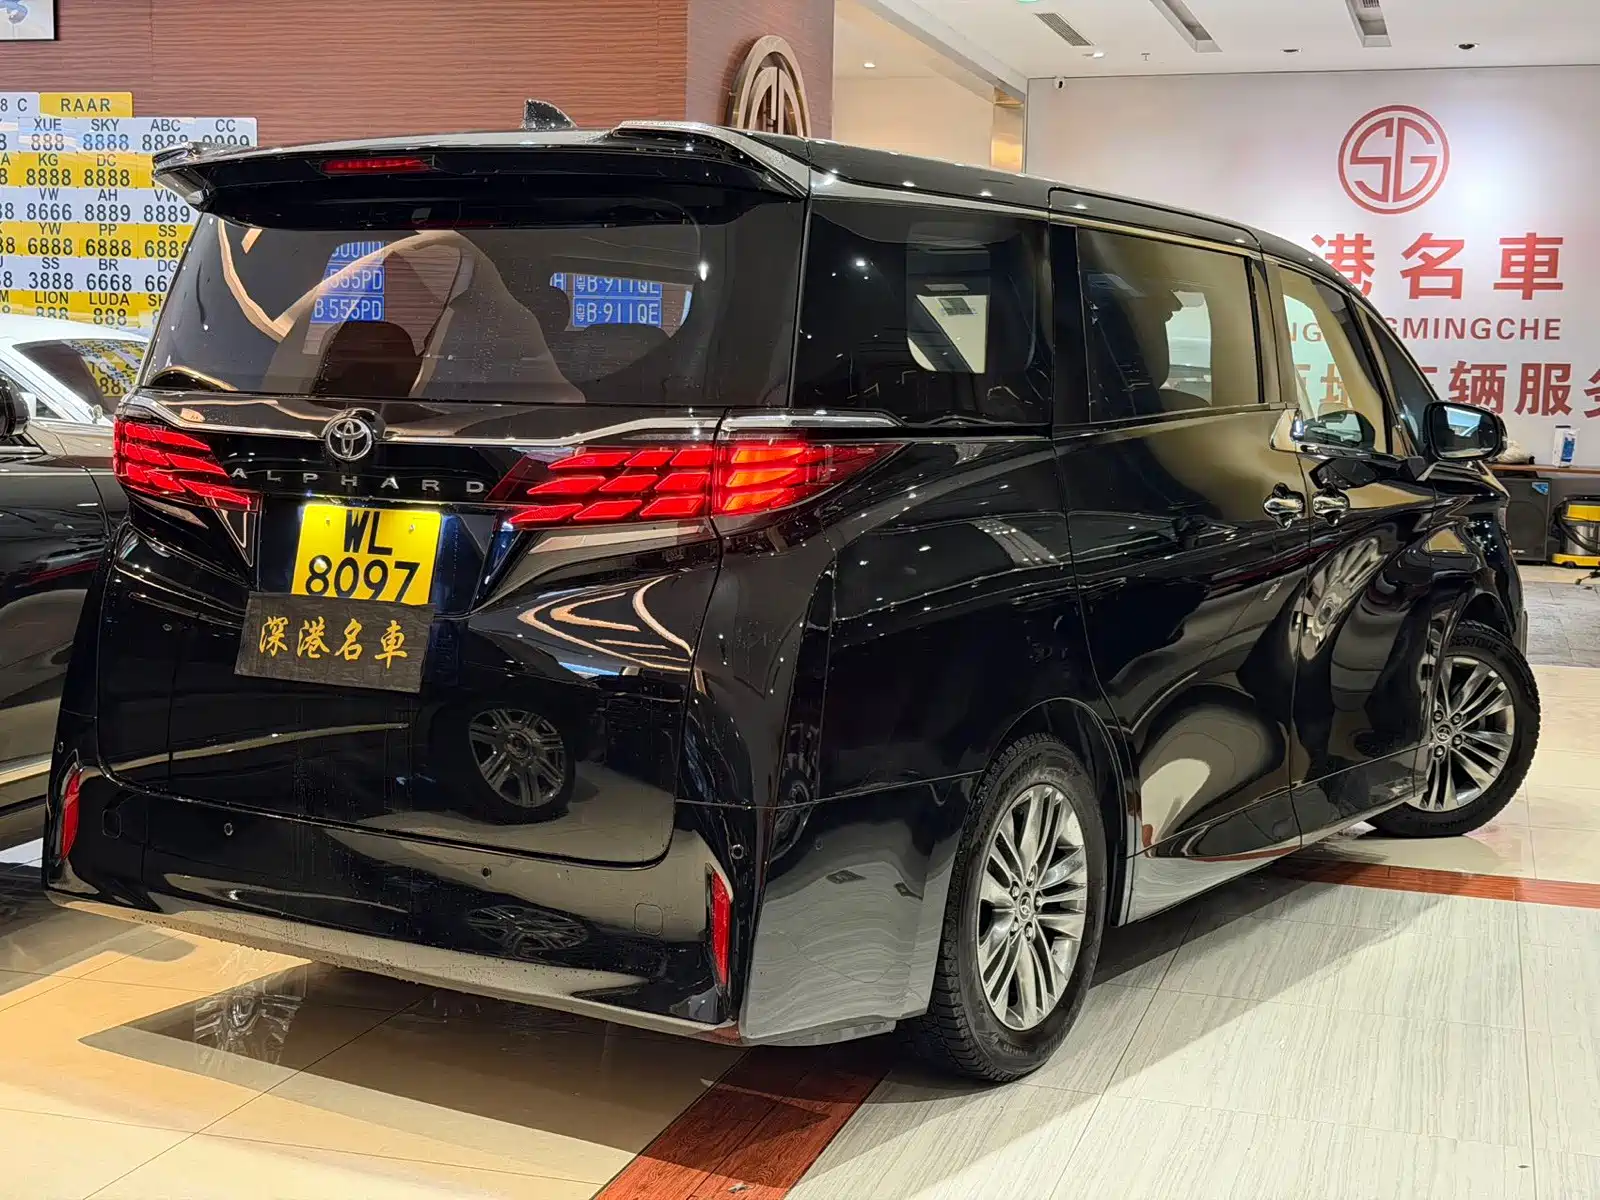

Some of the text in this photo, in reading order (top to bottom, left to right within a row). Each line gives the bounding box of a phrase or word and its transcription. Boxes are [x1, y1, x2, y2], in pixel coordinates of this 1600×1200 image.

[17, 98, 28, 112] C
[60, 98, 111, 112] RAAR
[34, 118, 62, 131] XUE
[91, 118, 120, 131] SKY
[149, 119, 181, 132] ABC
[215, 119, 236, 132] CC
[31, 133, 64, 151] 888
[83, 133, 129, 151] 8888
[38, 153, 58, 166] KG
[96, 153, 117, 167] DC
[26, 168, 71, 186] 8888
[84, 169, 130, 187] 8888
[39, 188, 59, 200] VW
[97, 188, 118, 201] AH
[0, 202, 14, 220] 8
[26, 203, 72, 220] 8666
[84, 204, 131, 222] 8889
[143, 205, 190, 223] 8889
[39, 222, 61, 235] YW
[98, 223, 117, 236] PP
[158, 225, 177, 237] SS
[28, 238, 73, 255] 6888
[85, 239, 131, 257] 6888
[145, 240, 187, 258] 688
[41, 257, 60, 269] SS
[98, 258, 119, 271] BR
[28, 272, 74, 290] 3888
[86, 273, 132, 291] 6668
[145, 274, 172, 292] 66
[34, 291, 69, 304] LION
[89, 292, 130, 306] LUDA
[93, 308, 127, 326] 888
[230, 467, 485, 494] ALPHARD
[343, 509, 393, 556] WL
[304, 554, 421, 604] 8097
[258, 615, 409, 669] 深港名車
